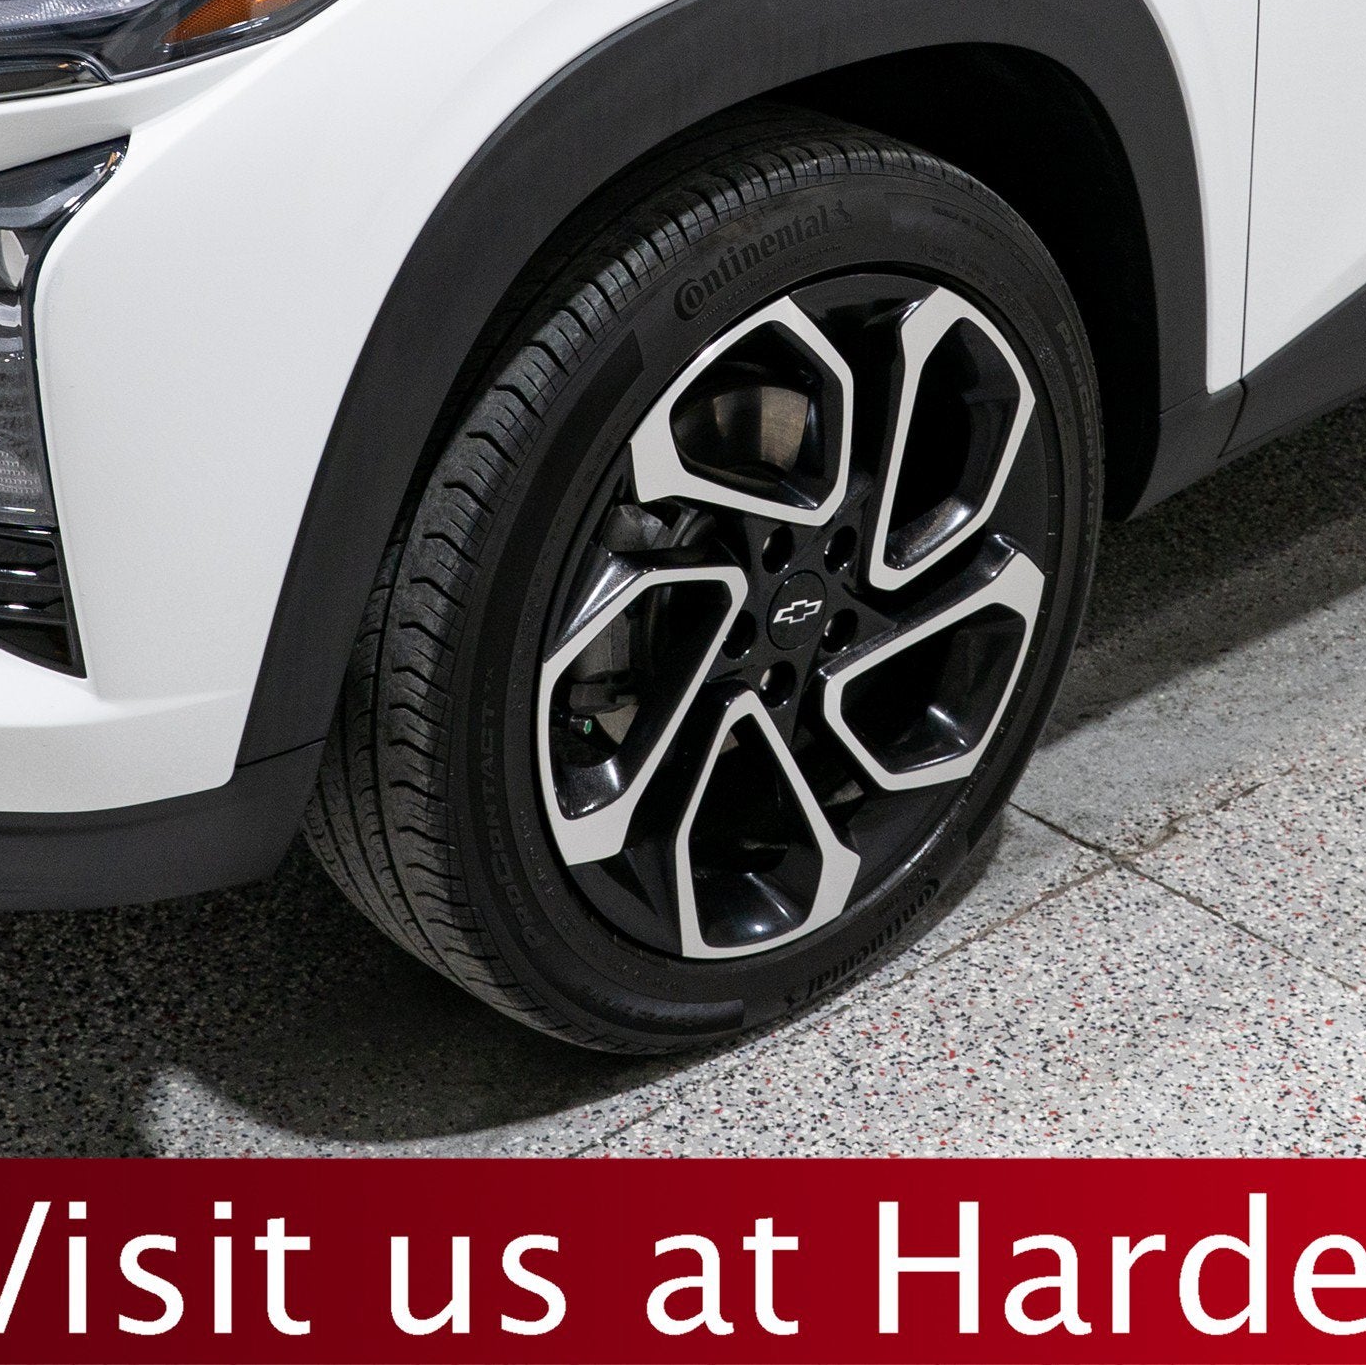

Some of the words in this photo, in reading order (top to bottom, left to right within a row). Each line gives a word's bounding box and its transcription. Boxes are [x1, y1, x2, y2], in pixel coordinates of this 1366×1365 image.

[673, 203, 830, 322] Continental
[479, 702, 547, 949] PROCONTACT
[806, 878, 941, 999] Continental
